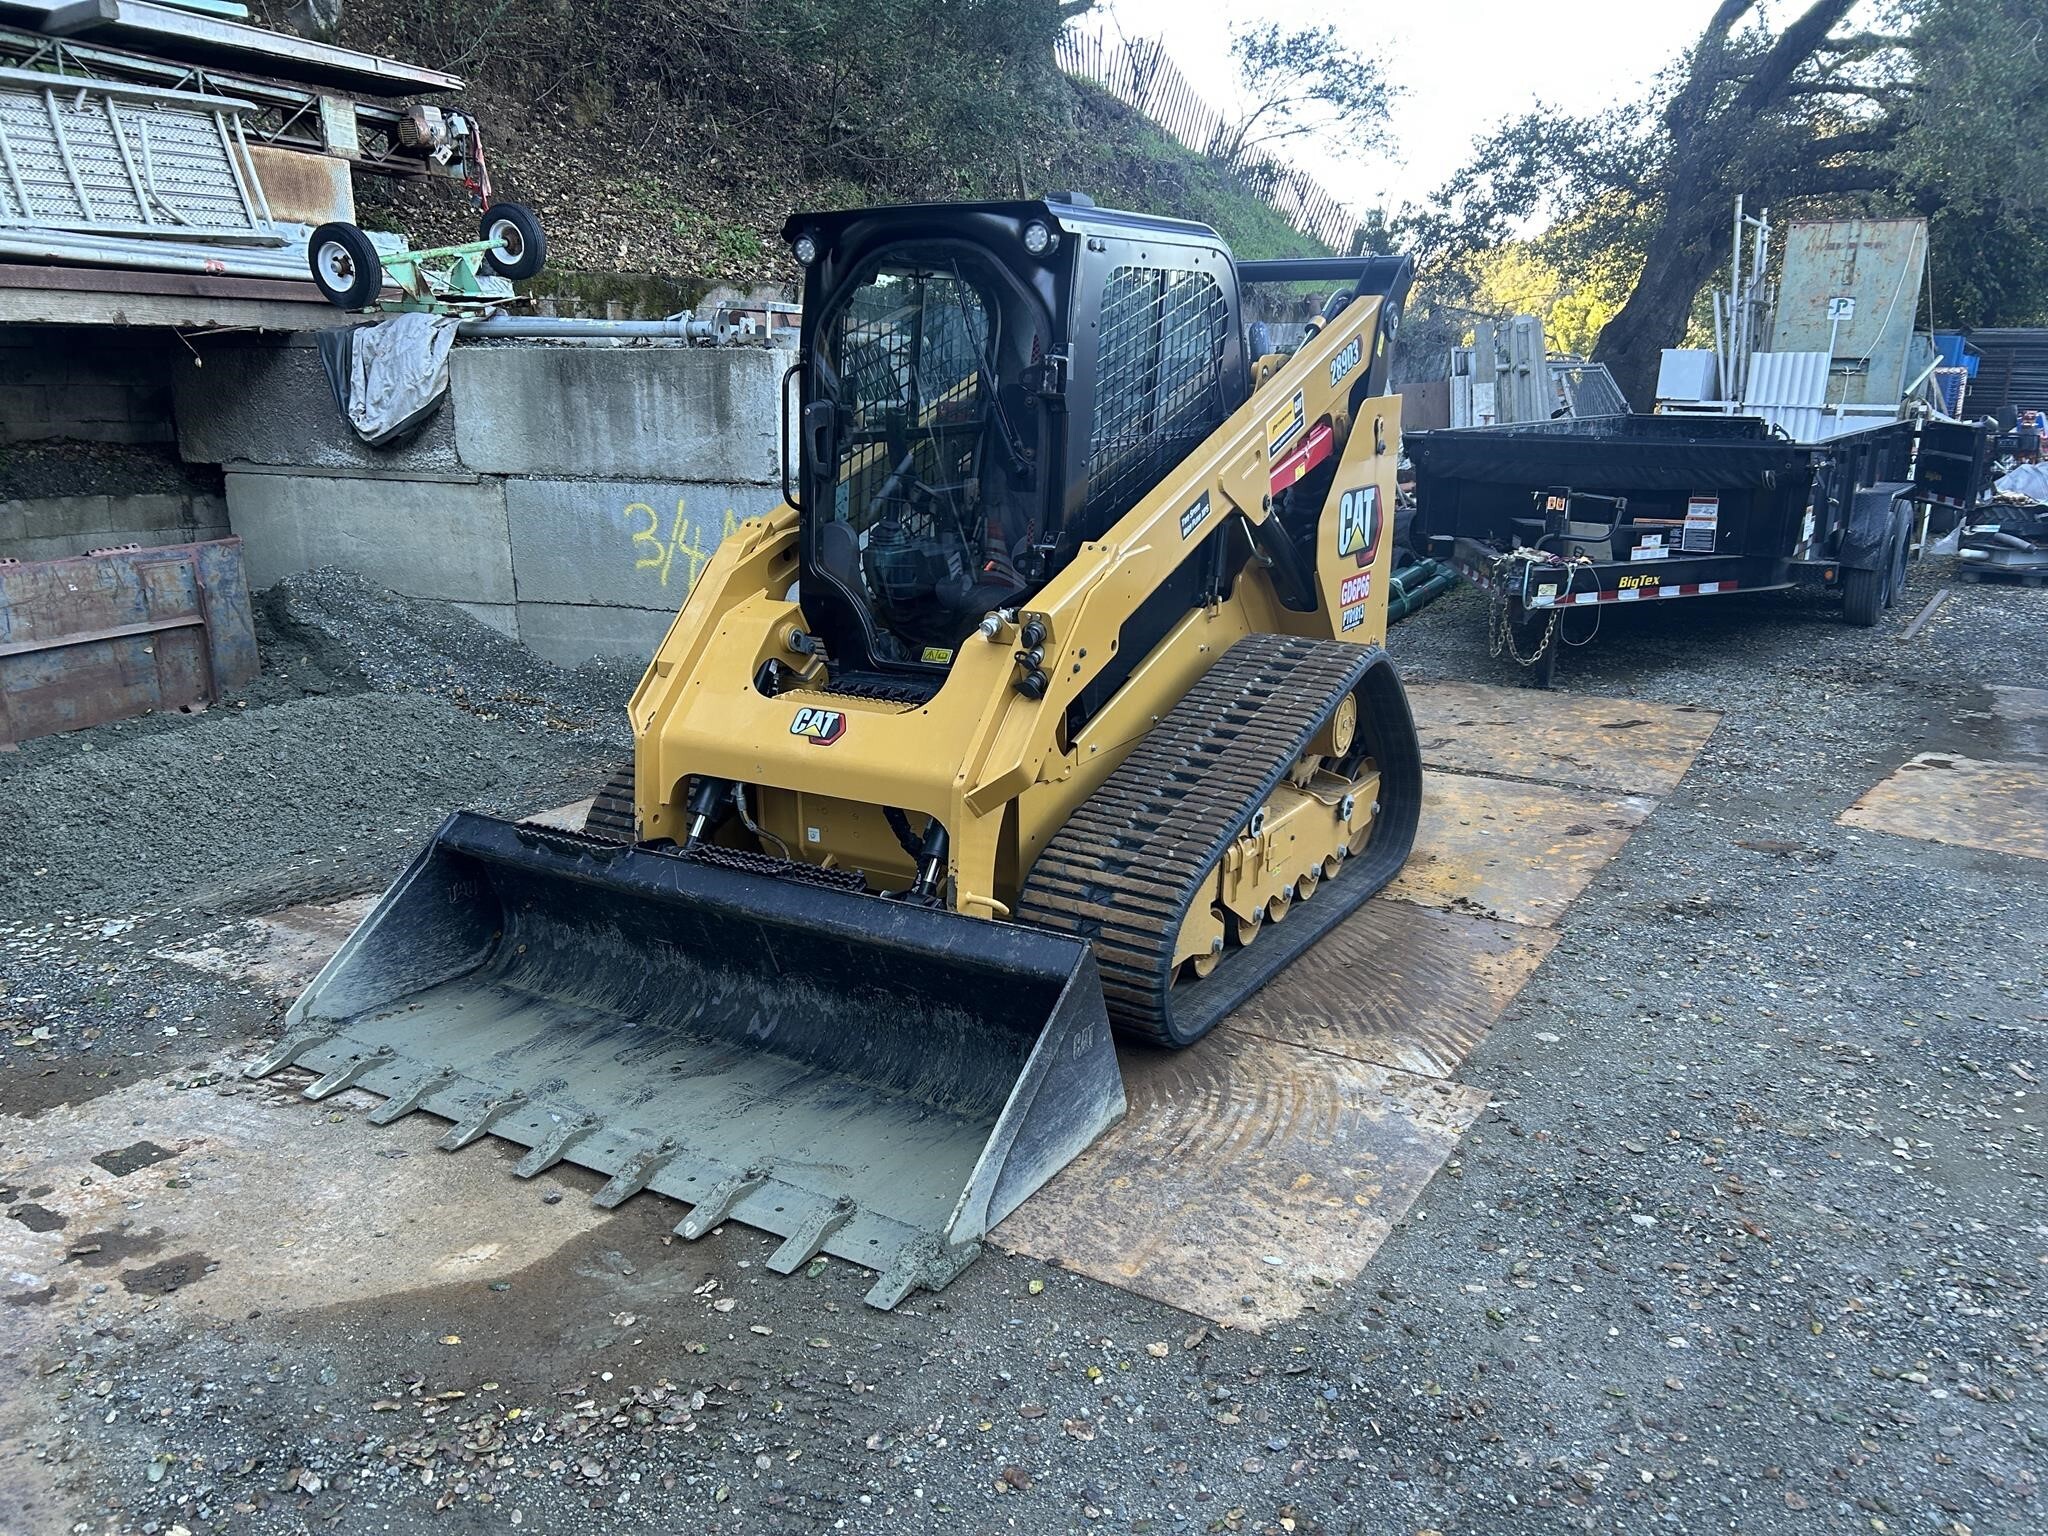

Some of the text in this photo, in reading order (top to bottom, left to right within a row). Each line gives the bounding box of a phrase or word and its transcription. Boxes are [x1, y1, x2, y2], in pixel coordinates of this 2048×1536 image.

[1330, 338, 1360, 387] 289D3
[624, 499, 706, 589] 3/4
[1340, 487, 1376, 556] CAT
[1618, 574, 1661, 590] BigTex
[790, 708, 840, 738] CAT
